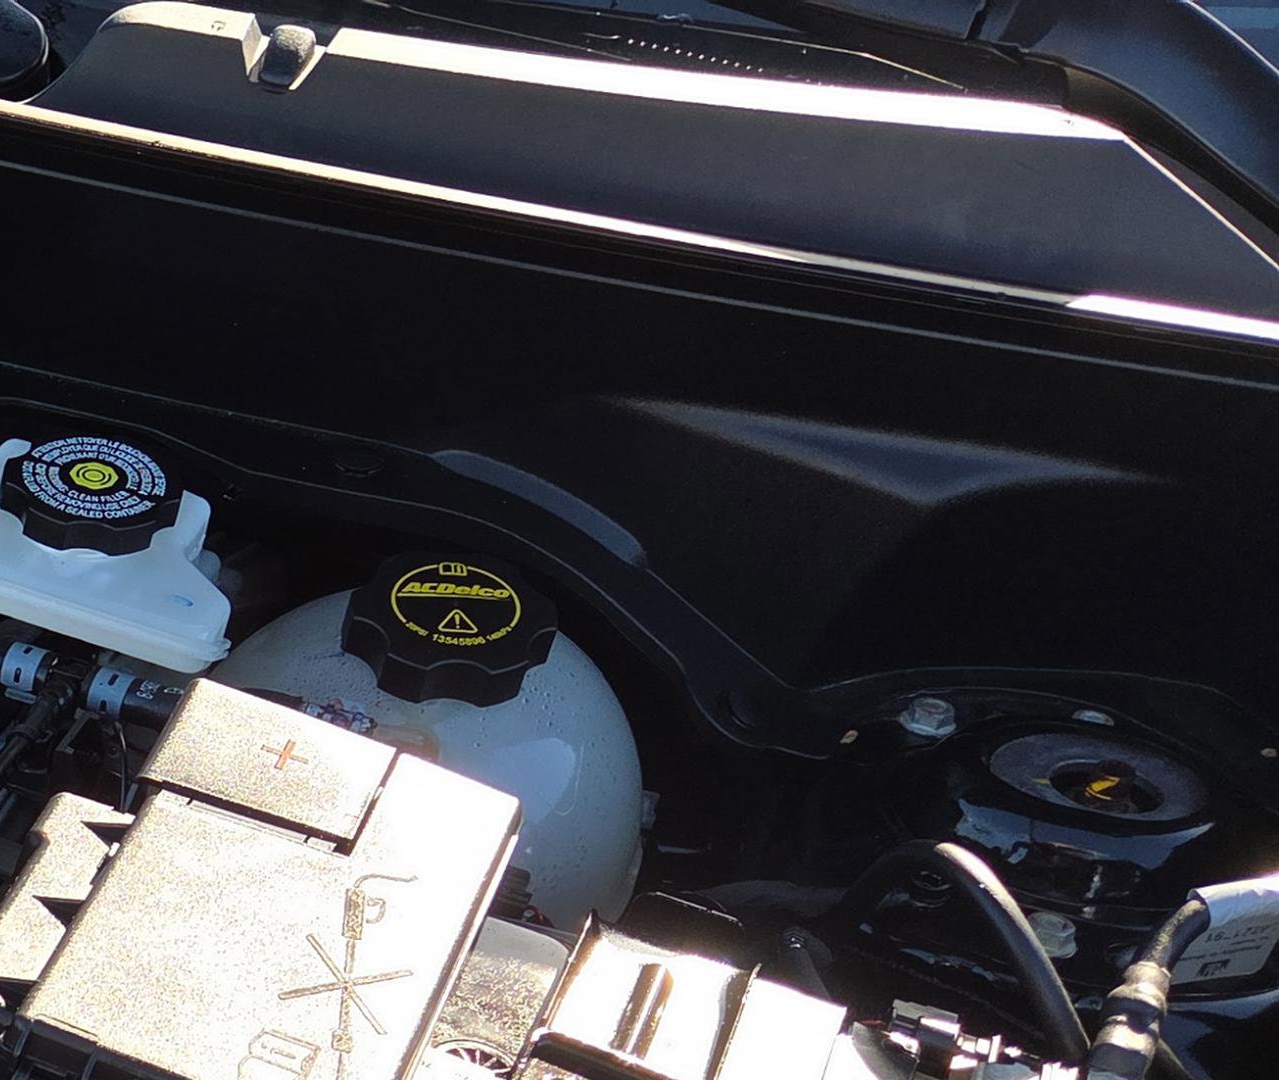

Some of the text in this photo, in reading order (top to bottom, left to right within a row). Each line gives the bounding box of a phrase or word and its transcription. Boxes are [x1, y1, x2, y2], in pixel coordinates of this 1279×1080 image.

[68, 490, 99, 502] CLEAN
[100, 490, 130, 502] FILLER
[34, 491, 60, 508] FROM
[57, 503, 67, 511] A
[64, 505, 103, 519] SEALED
[401, 582, 510, 598] ACDelco
